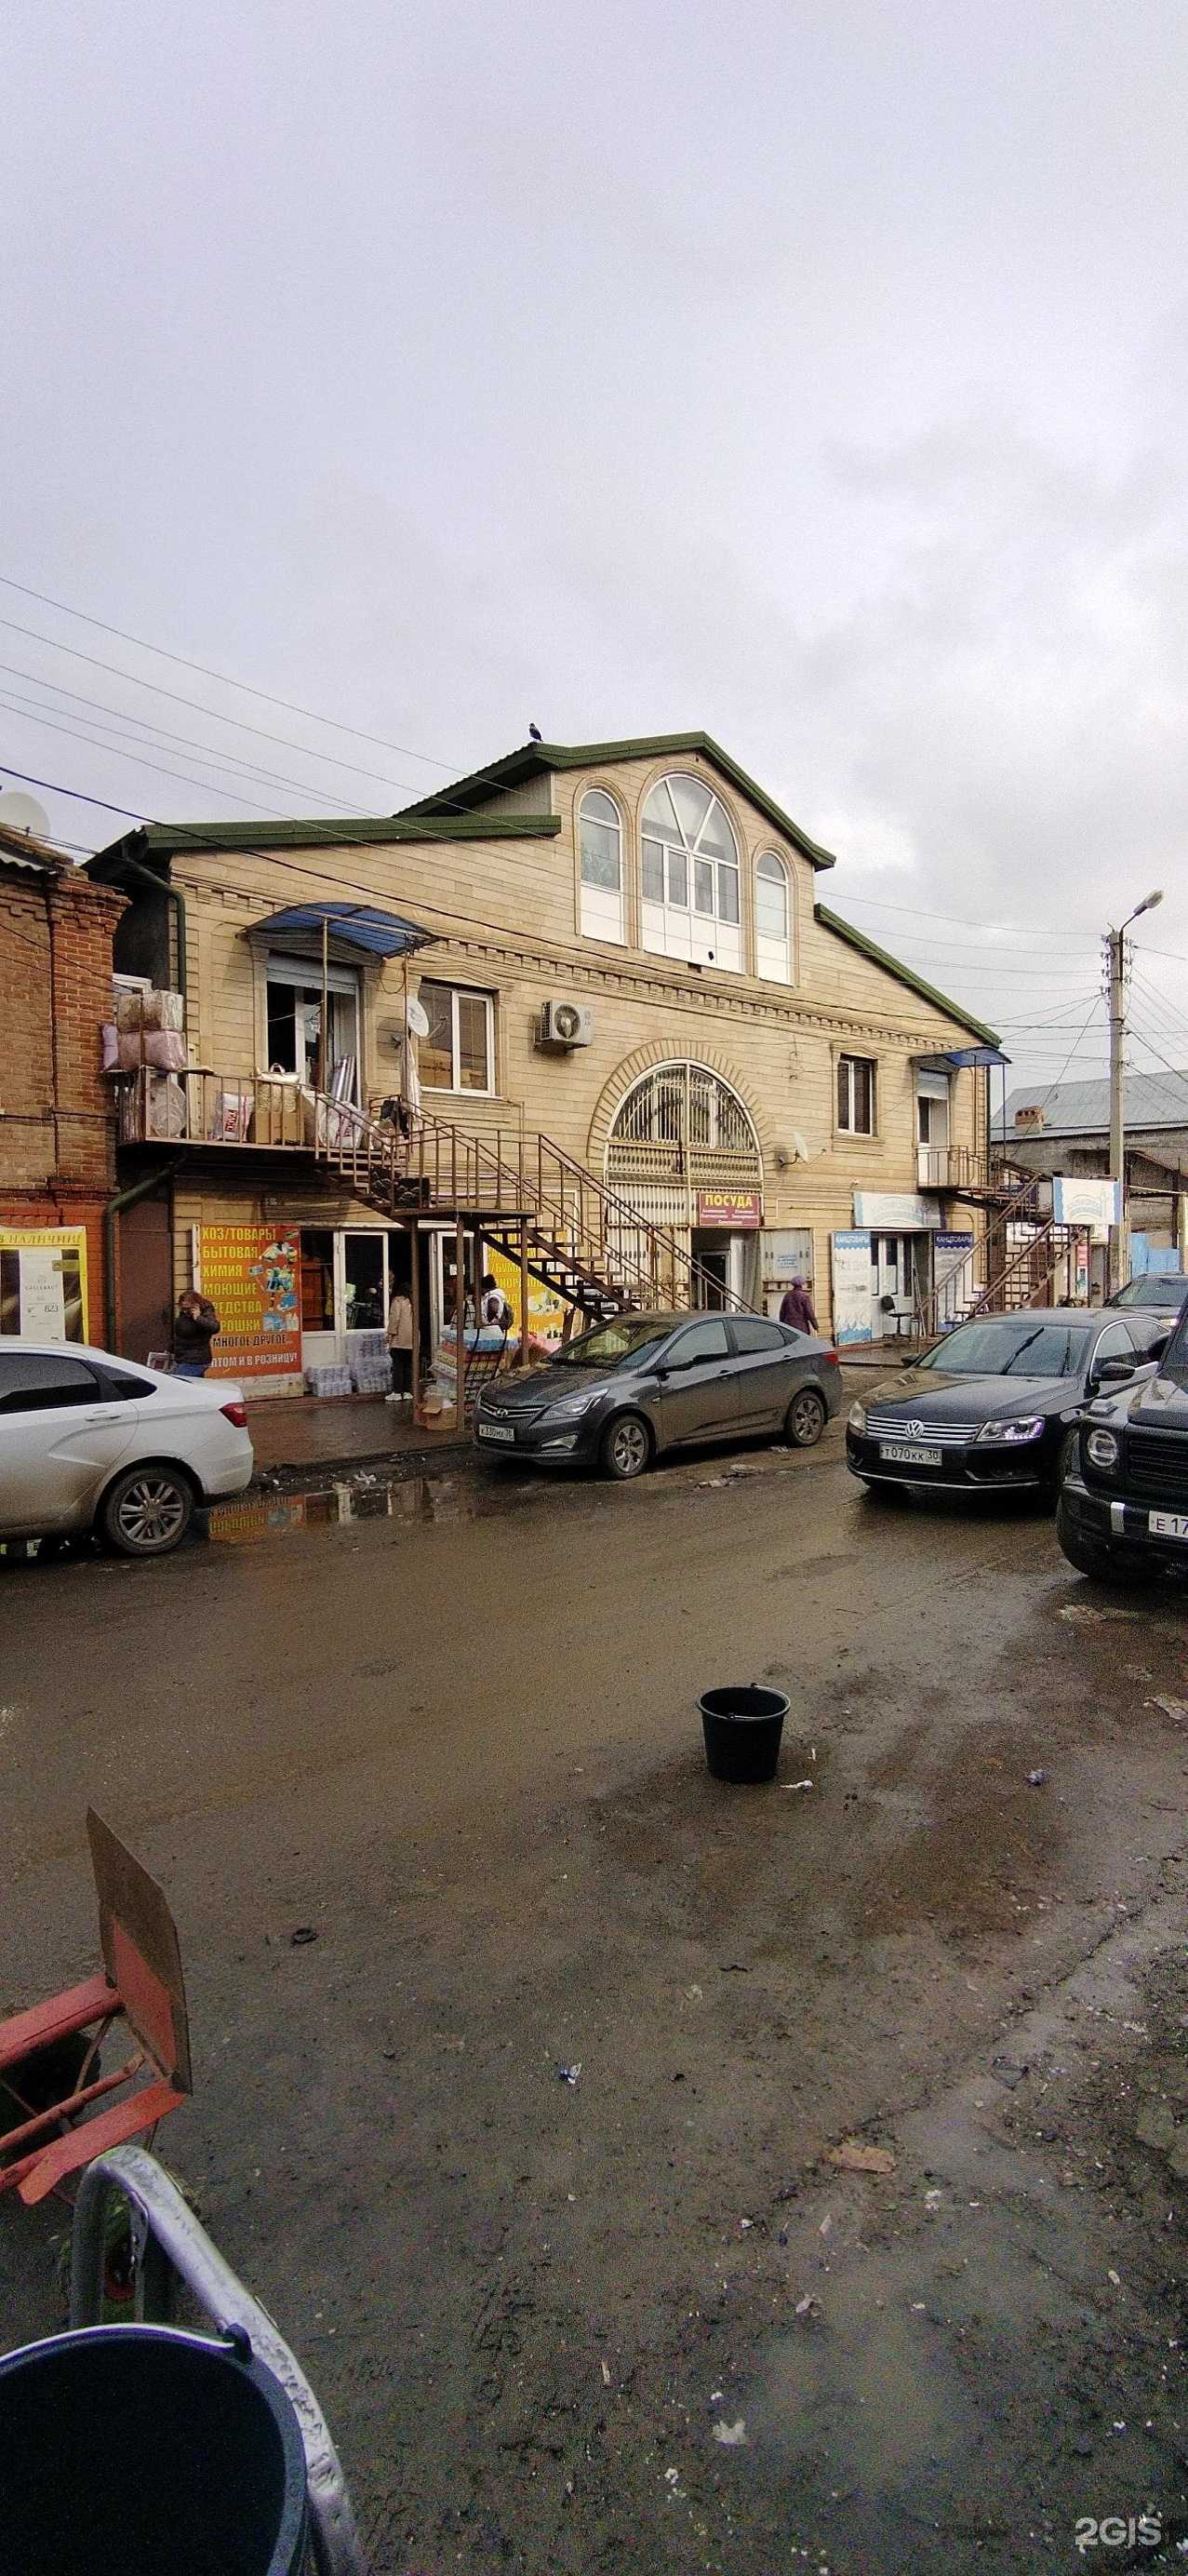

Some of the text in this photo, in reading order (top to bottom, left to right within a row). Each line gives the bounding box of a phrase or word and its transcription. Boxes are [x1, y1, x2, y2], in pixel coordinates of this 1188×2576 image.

[705, 1194, 754, 1209] ПОСУДА
[203, 1228, 276, 1241] ХОЗ/ТОВАРЫ
[203, 1246, 259, 1259] БЫТОВАЯ
[203, 1265, 243, 1277] ХИМИЯ
[204, 1283, 258, 1295] МОЮЩИЕ
[220, 1320, 260, 1332] РОШКИ
[211, 1357, 237, 1368] ПТОМ
[254, 1352, 298, 1365] РОЗНИЦУ!
